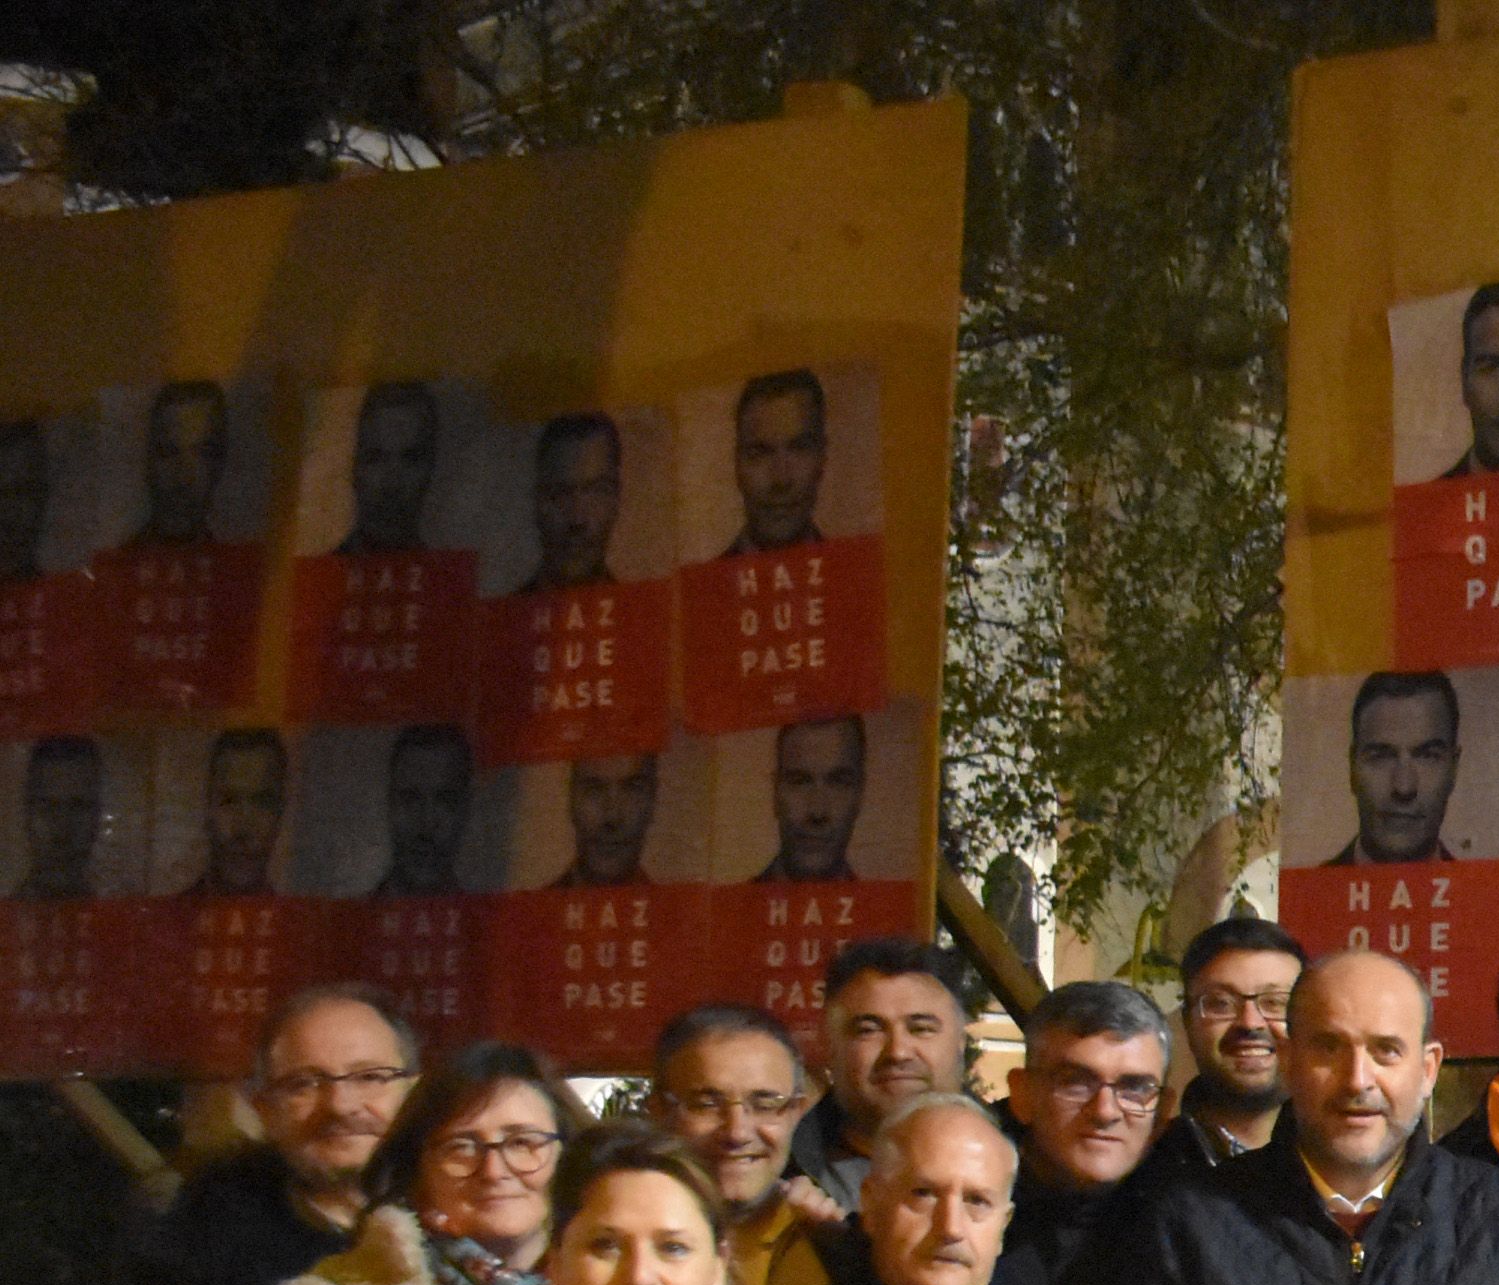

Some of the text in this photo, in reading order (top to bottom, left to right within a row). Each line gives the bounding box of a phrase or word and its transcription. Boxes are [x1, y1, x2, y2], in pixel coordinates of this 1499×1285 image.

[346, 566, 424, 592] HAZ
[739, 557, 824, 596] HAZ
[342, 602, 420, 631] QUE
[533, 598, 615, 632] HAZ
[740, 598, 825, 636] QUE
[342, 643, 418, 670] PASE
[533, 639, 615, 673] QUE
[740, 639, 826, 679] PASE
[533, 679, 614, 711] PASE
[1349, 878, 1450, 911] HAZ
[564, 899, 650, 931] HAZ
[768, 898, 855, 927] HAZ
[1348, 923, 1449, 951] QUE
[564, 940, 649, 970] QUE
[402, 988, 458, 1016] ASE
[564, 980, 648, 1008] PASE
[766, 980, 826, 1010] PAS
